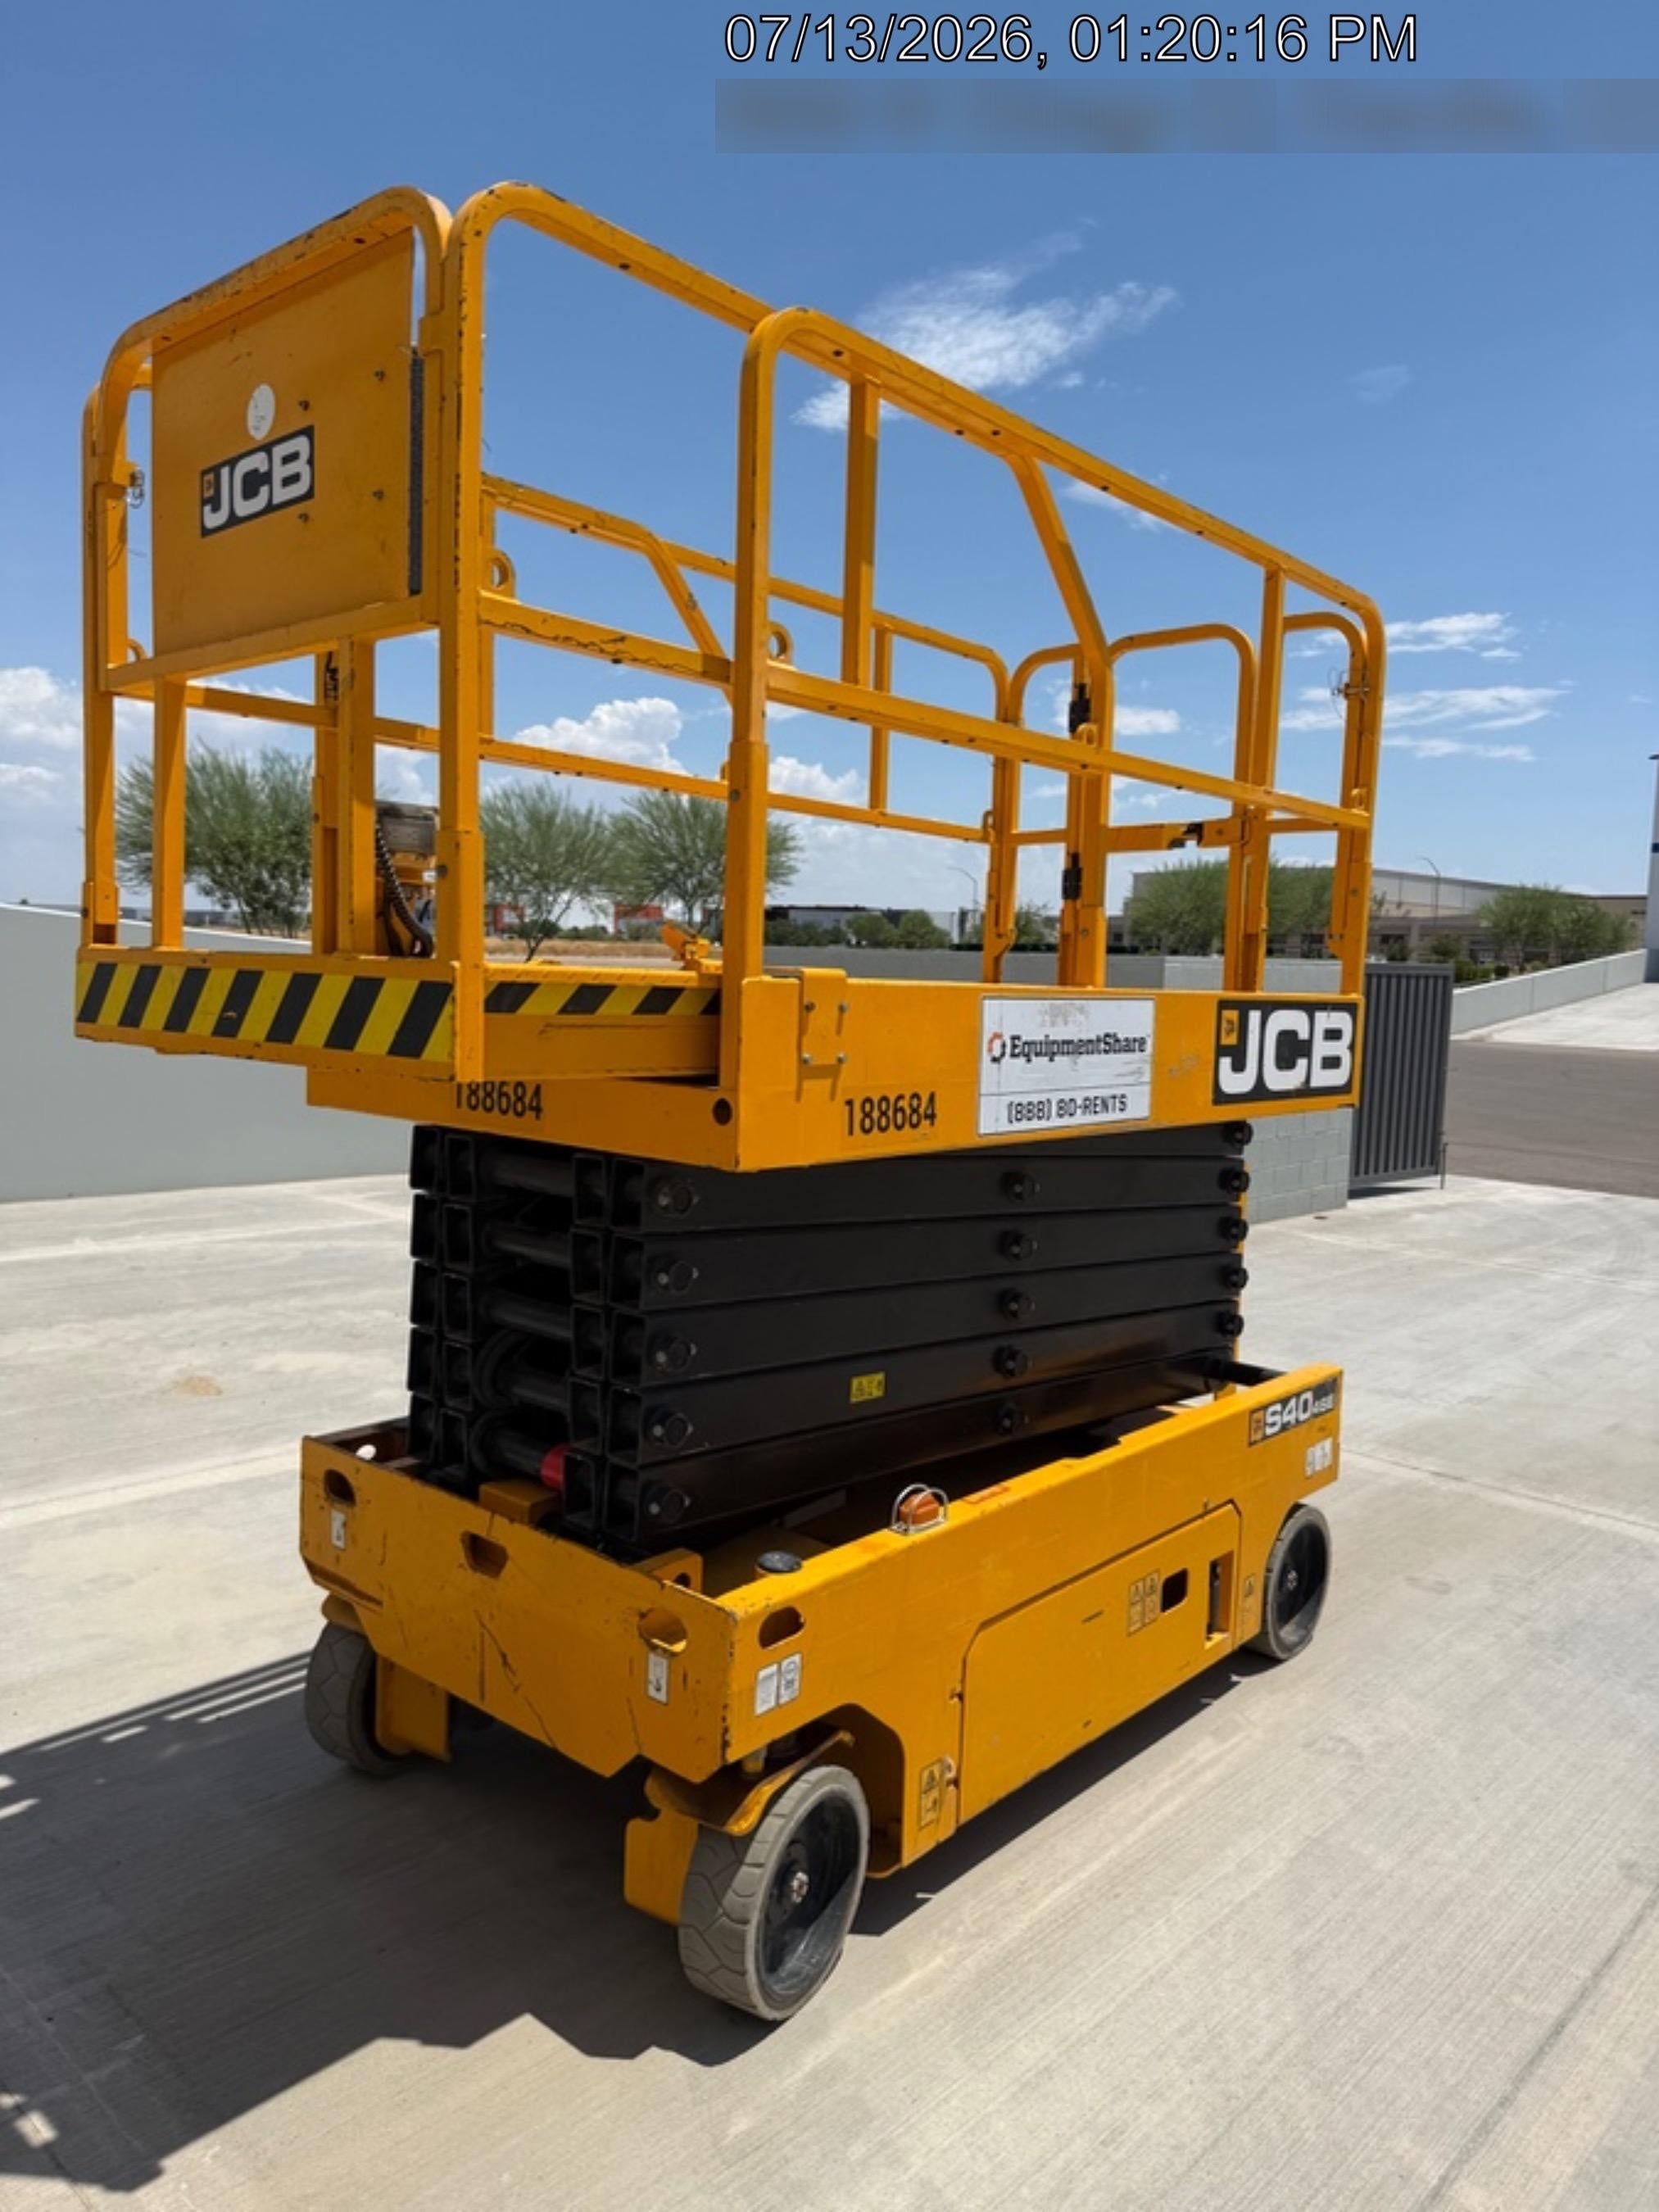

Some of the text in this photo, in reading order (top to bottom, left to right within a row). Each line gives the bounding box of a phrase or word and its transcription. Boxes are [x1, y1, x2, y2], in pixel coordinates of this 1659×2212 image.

[202, 434, 312, 530] JCB
[1009, 1032, 1146, 1063] EquipmentShare
[1218, 1009, 1353, 1095] JCB
[456, 1080, 542, 1120] 188684
[845, 1091, 936, 1135] 188684
[1008, 1094, 1127, 1124] (888) 80-RENTS
